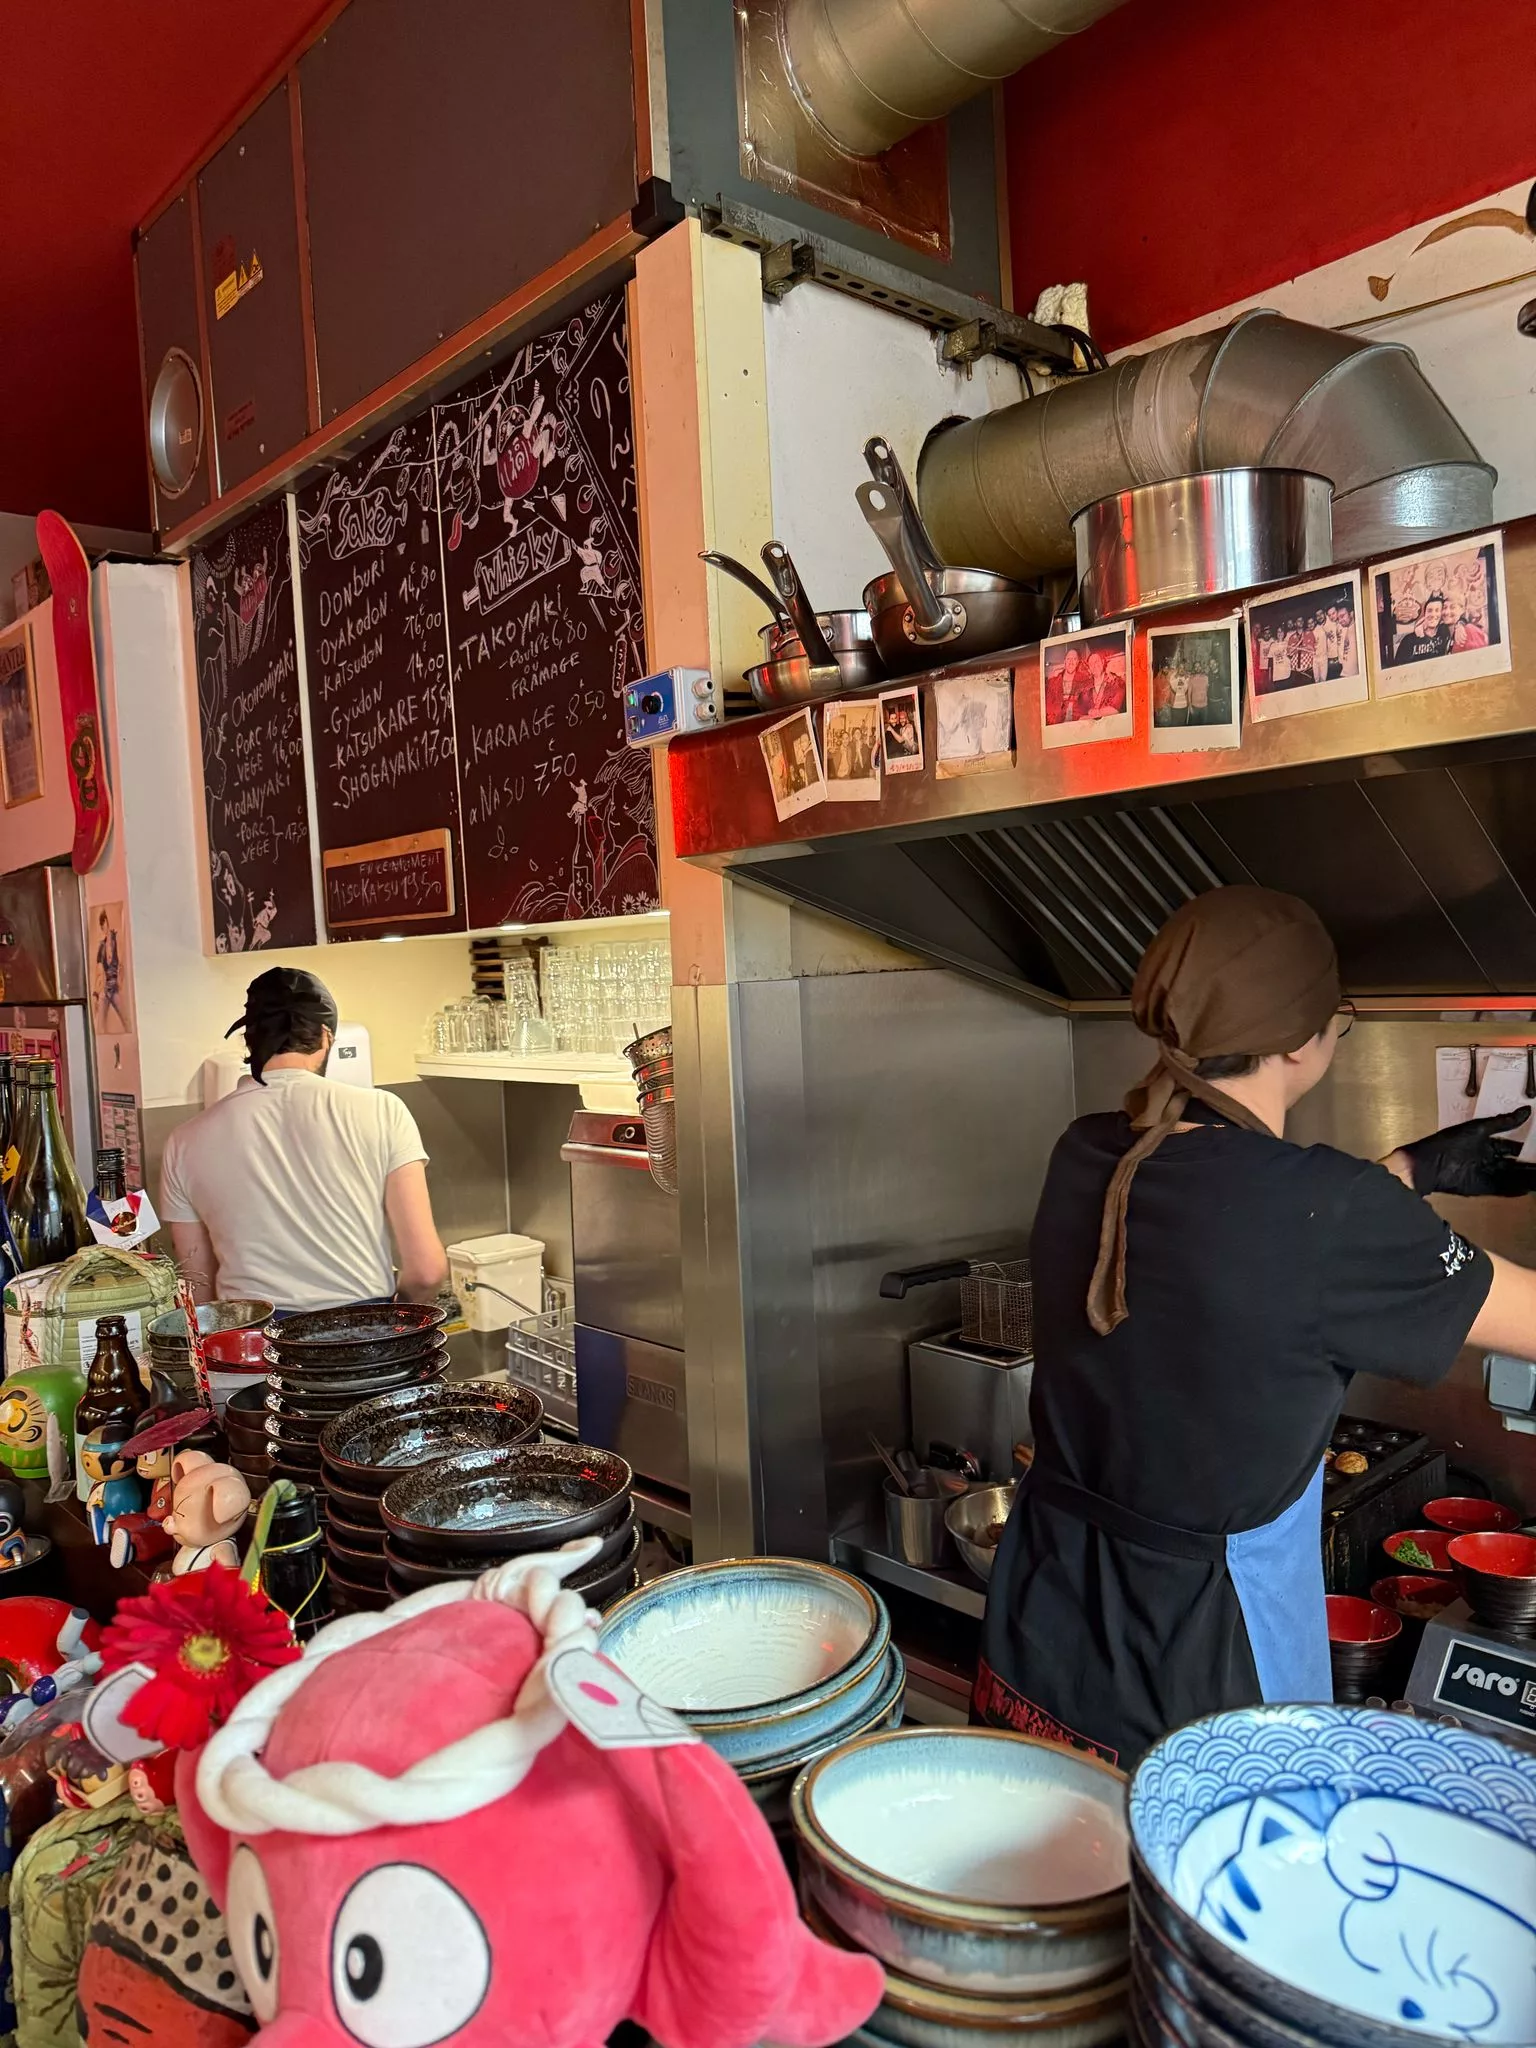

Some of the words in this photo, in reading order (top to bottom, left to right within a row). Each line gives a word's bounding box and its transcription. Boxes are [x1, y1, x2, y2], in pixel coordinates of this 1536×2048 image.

[480, 527, 559, 600] Whisky
[471, 704, 557, 765] KARAAGE
[479, 774, 525, 822] NASU
[1450, 1663, 1518, 1697] saro
